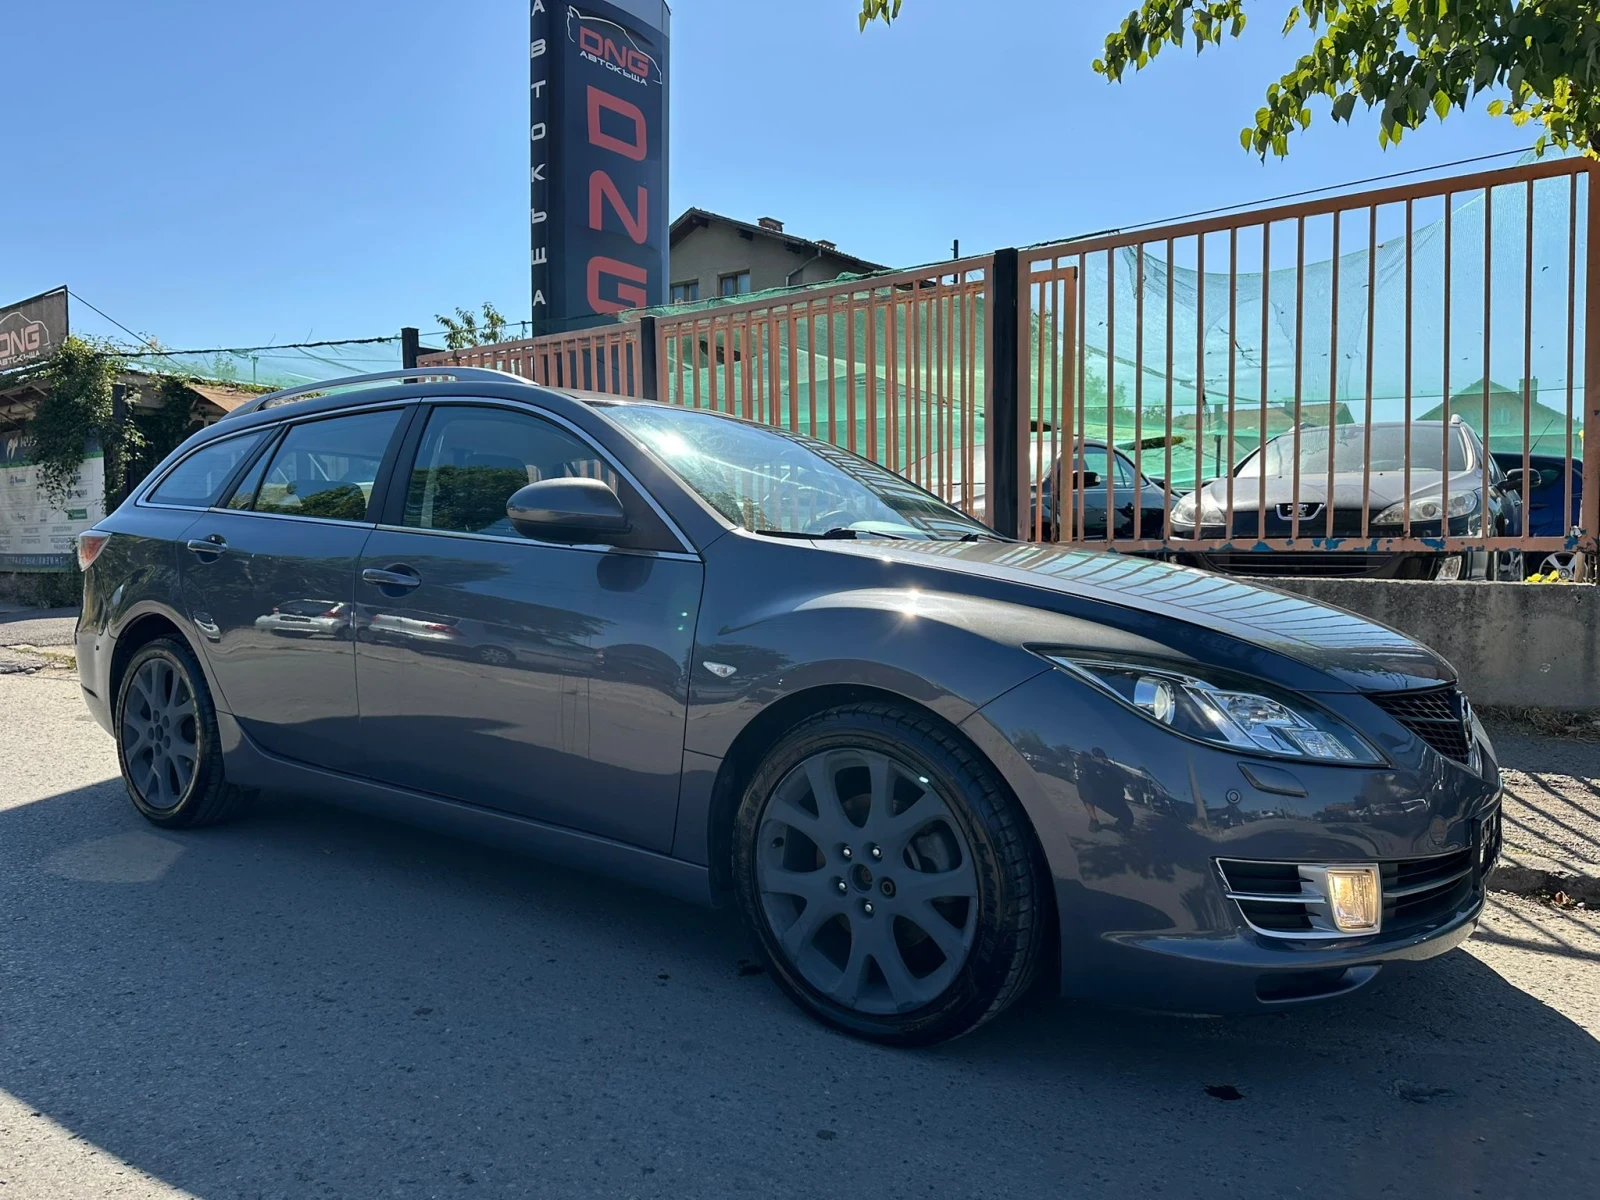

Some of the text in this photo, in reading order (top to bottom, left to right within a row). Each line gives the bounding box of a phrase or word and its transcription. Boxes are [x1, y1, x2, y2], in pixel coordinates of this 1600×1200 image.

[579, 25, 649, 78] DNG
[579, 50, 648, 87] АВТОКЪЩА
[586, 84, 648, 317] DNG
